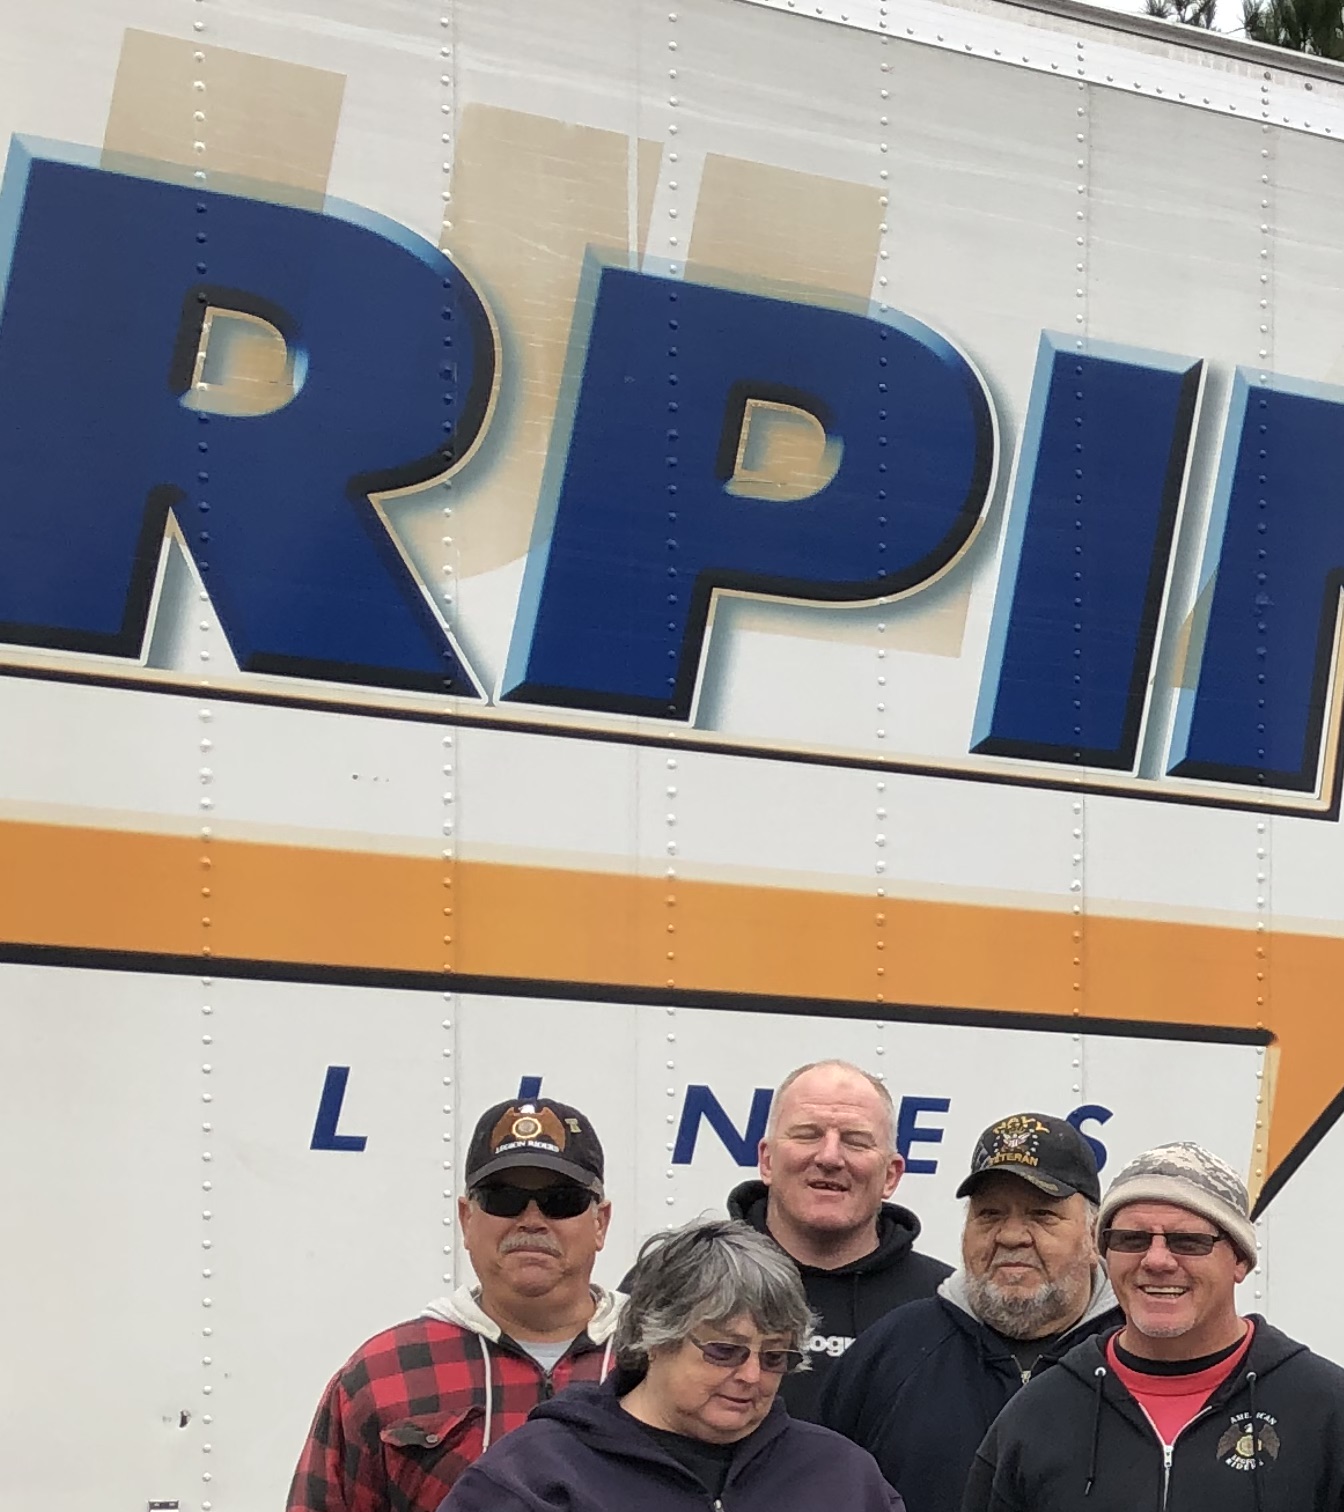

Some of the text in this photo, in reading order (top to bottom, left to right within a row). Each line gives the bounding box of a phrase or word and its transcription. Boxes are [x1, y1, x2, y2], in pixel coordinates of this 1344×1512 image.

[993, 1115, 1051, 1135] NAVY
[495, 1140, 526, 1154] LEGION
[987, 1152, 1039, 1167] VETERAN
